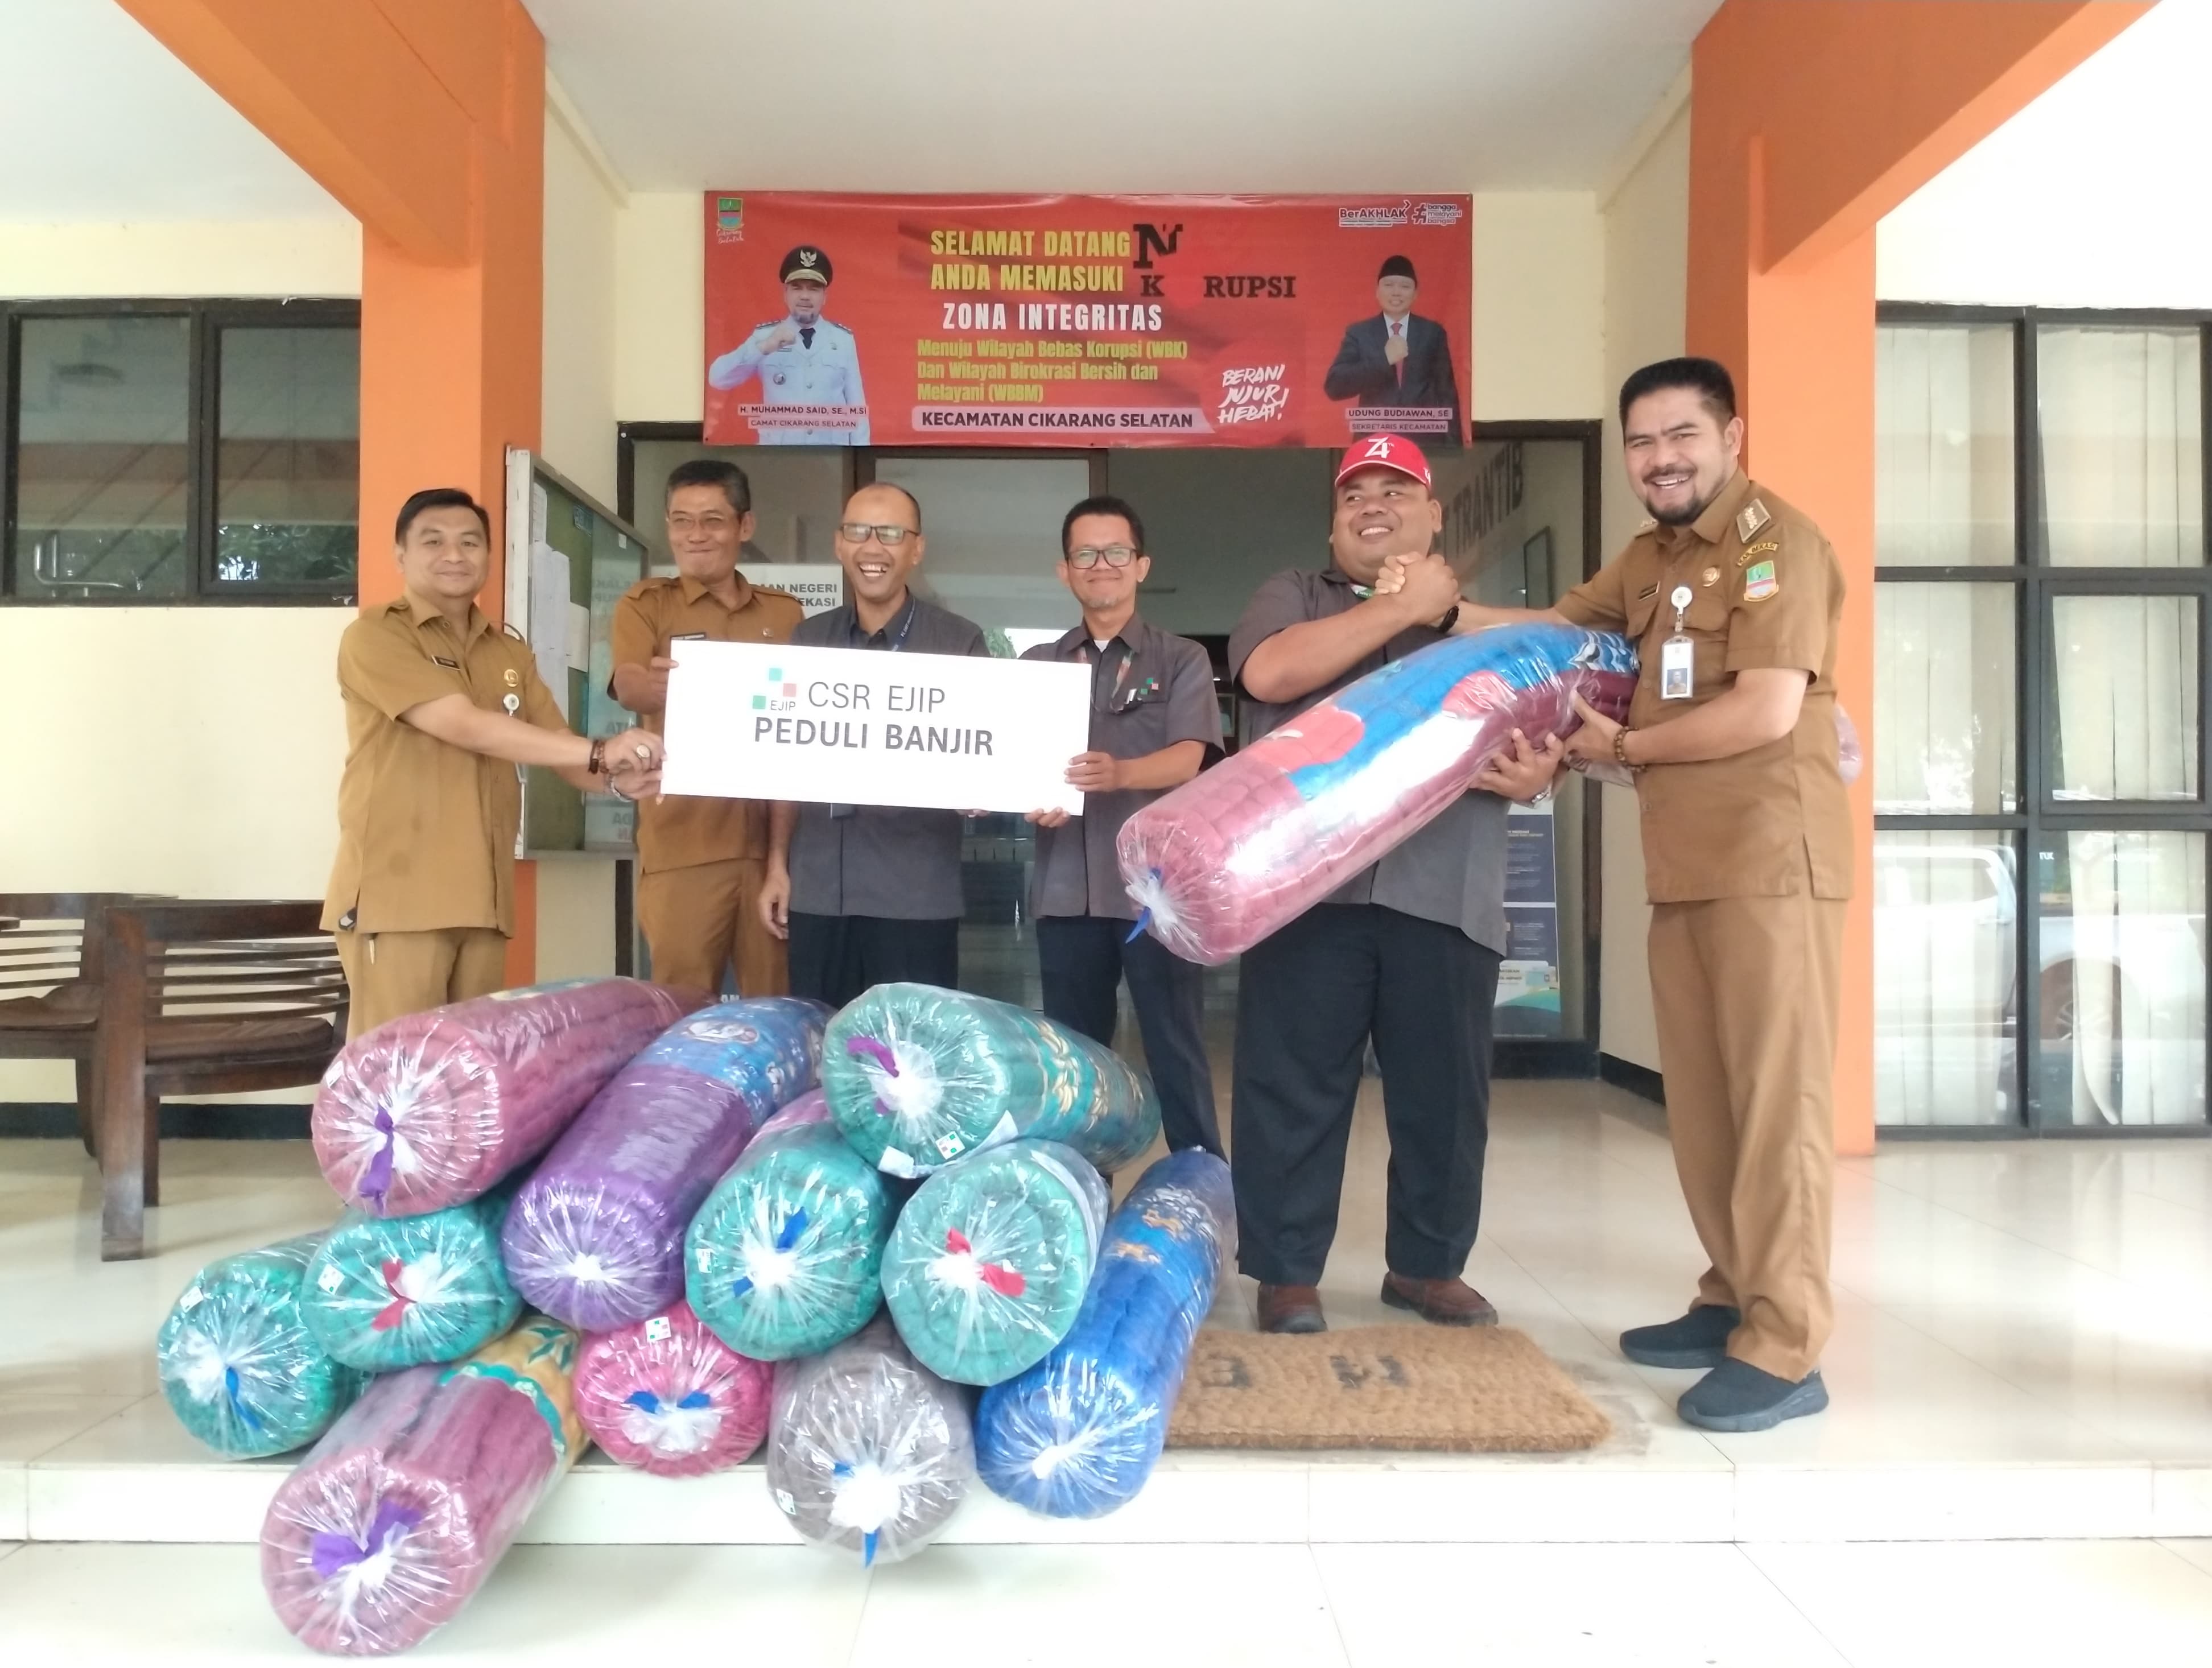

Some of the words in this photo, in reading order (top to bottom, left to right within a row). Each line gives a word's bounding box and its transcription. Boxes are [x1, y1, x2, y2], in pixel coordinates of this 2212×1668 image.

[1339, 207, 1407, 218] BerAKHLAK
[931, 231, 1034, 256] SELAMAT
[1044, 231, 1130, 257] DATANG
[931, 264, 991, 290] ANDA
[1000, 265, 1124, 291] MEMASUKI
[943, 303, 1006, 329] ZONA
[1019, 304, 1162, 331] INTEGRITAS
[918, 339, 972, 358] Menuju
[977, 340, 1034, 359] Wilayah
[1038, 341, 1083, 358] Bebas
[1087, 341, 1142, 360] Korupsi
[1146, 341, 1187, 360] (WBK)
[918, 362, 944, 378] Dan
[950, 362, 1006, 381] Wilayah
[1010, 362, 1076, 379] Birokrasi
[1081, 362, 1126, 380] Bersih
[1131, 363, 1158, 380] dan
[1223, 364, 1286, 387] BERANI
[918, 383, 984, 403] Melayani
[988, 385, 1043, 403] (WBBM)
[1218, 385, 1280, 408] JUJUR
[806, 407, 829, 415] SAID,
[922, 412, 1024, 426] KECAMATAN
[1028, 412, 1116, 427] CIKARANG
[1120, 414, 1193, 428] SELATAN
[1384, 410, 1435, 418] BUDIAWAN,
[790, 584, 837, 593] NEGERI
[800, 597, 836, 607] EKASI
[770, 700, 796, 711] EJIP
[808, 682, 870, 710] CSR
[888, 686, 946, 713] EJIP
[755, 717, 868, 749] PEDULI
[885, 724, 993, 756] BANJIR
